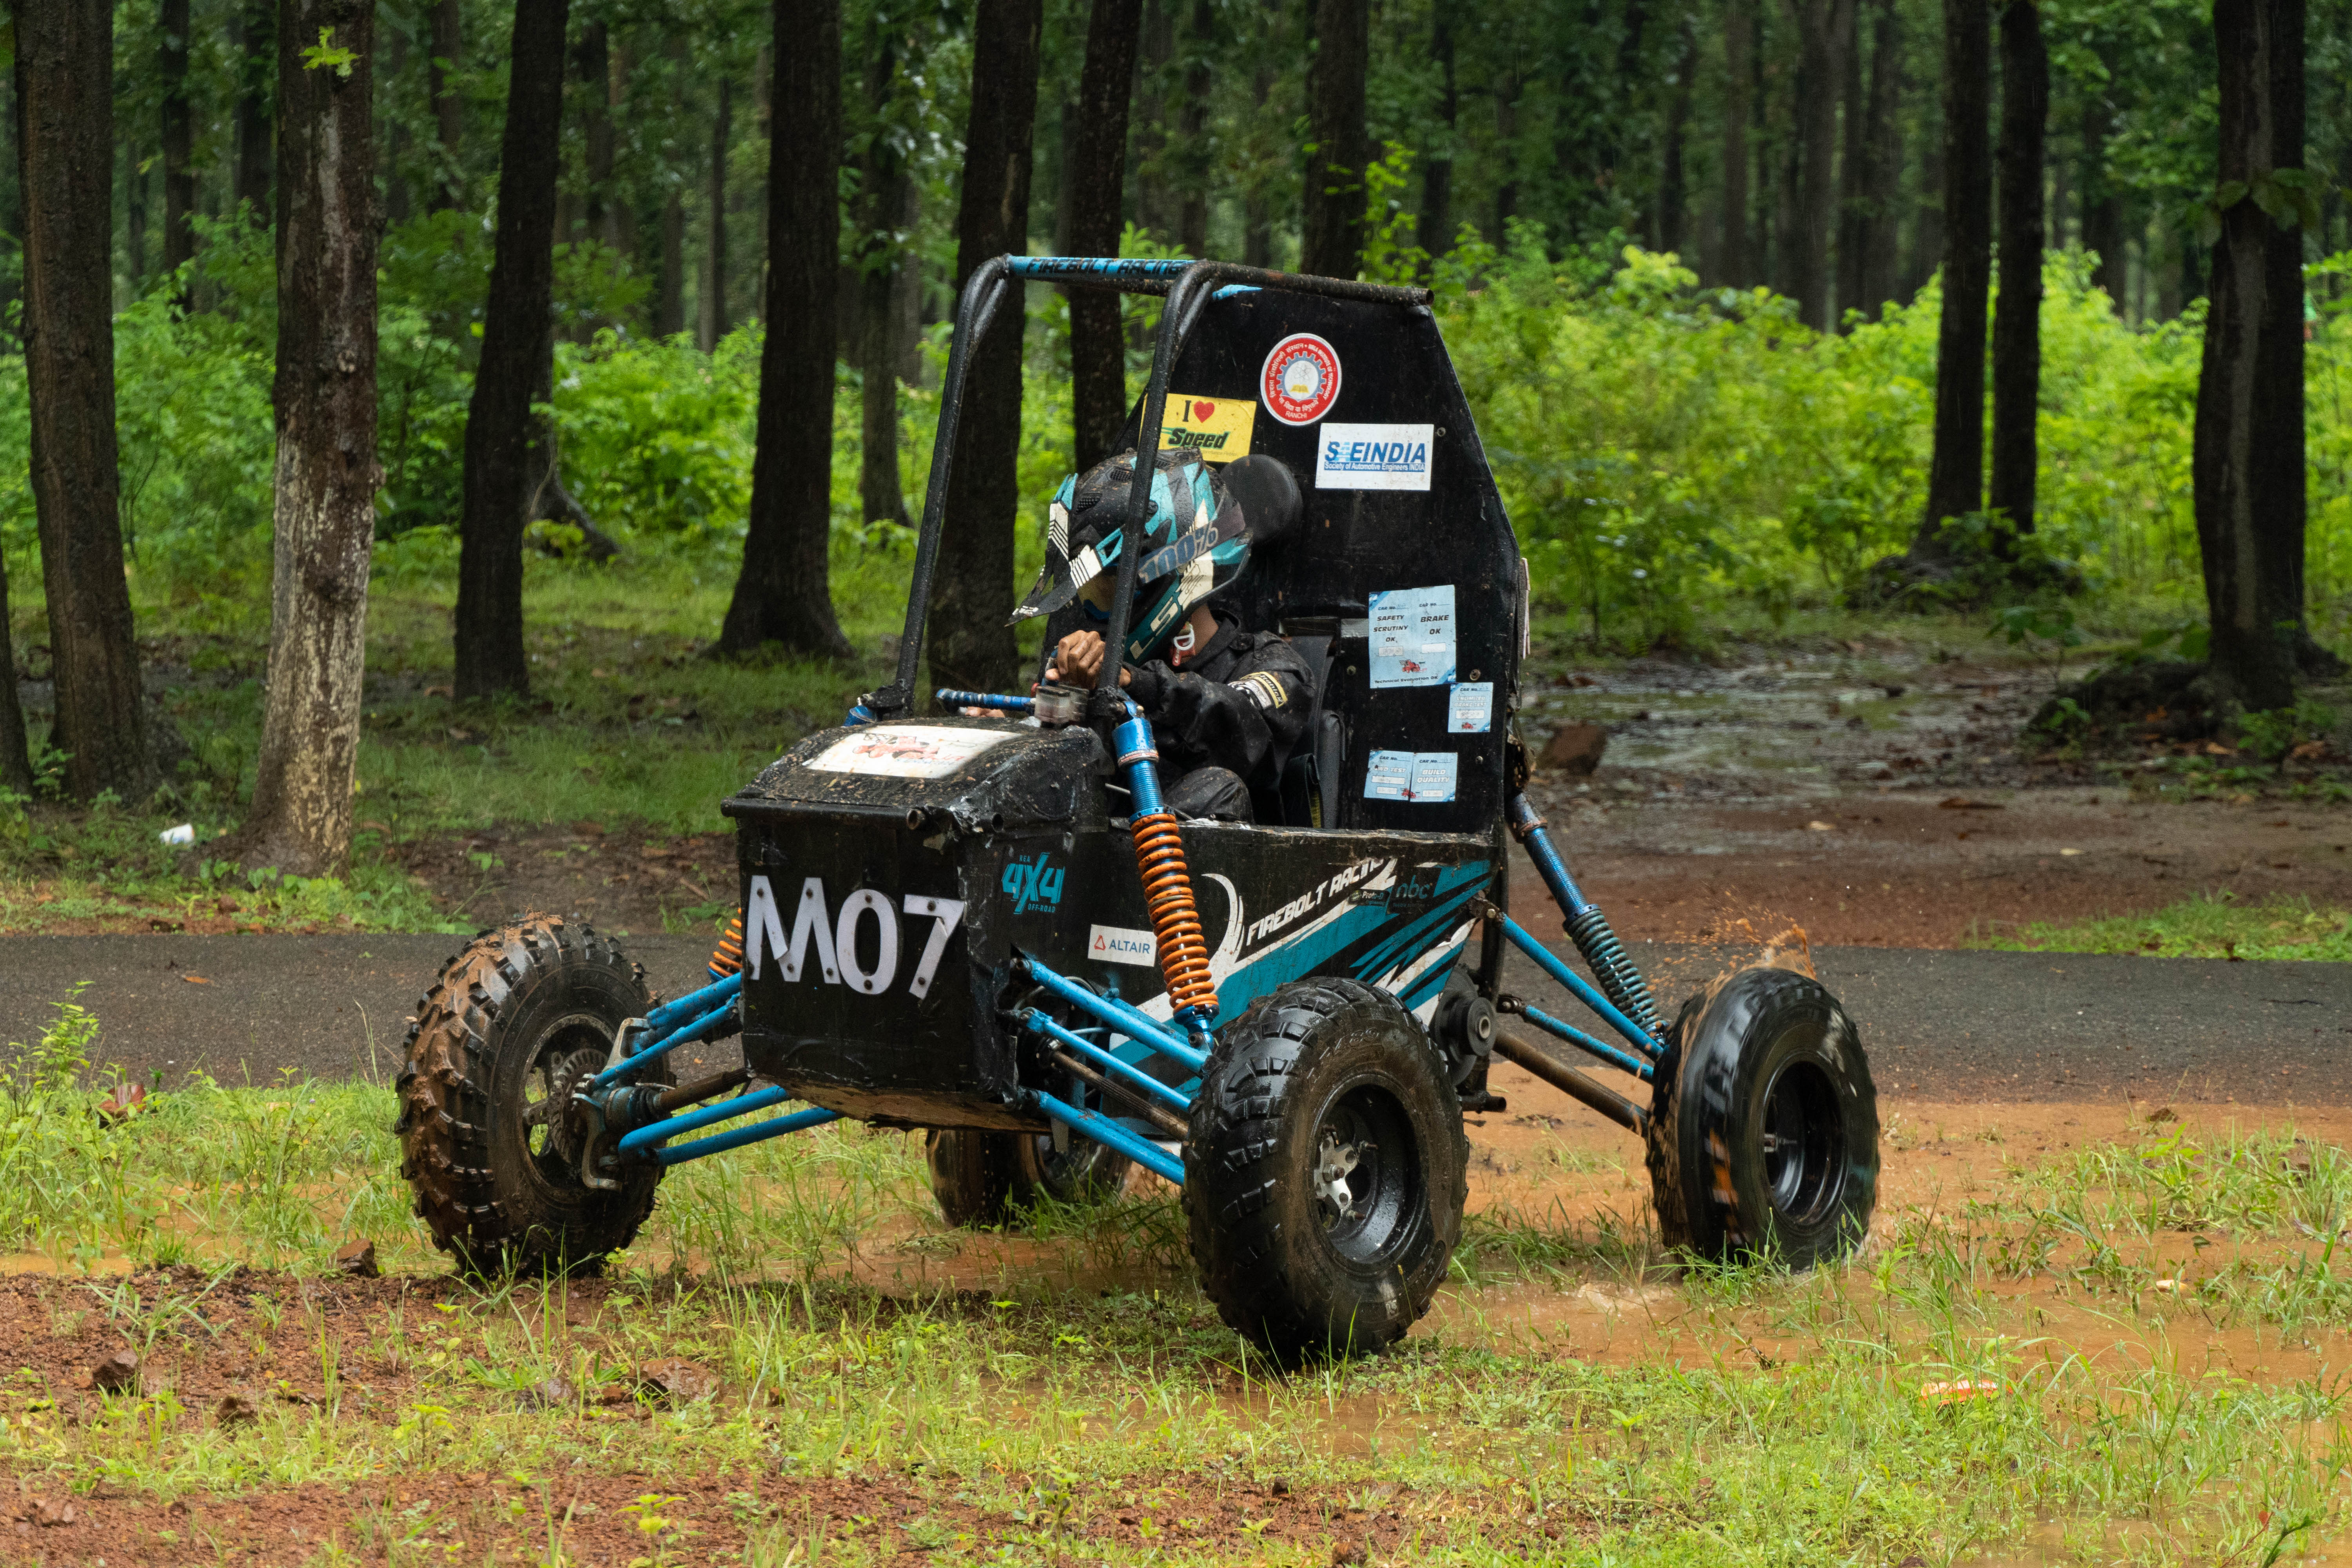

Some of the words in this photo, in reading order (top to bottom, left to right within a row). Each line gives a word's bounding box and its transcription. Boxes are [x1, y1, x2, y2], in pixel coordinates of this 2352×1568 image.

[1182, 400, 1191, 422] I
[1168, 427, 1230, 450] Speed
[1381, 463, 1408, 472] Engineers
[1138, 524, 1218, 584] 100%
[1420, 614, 1449, 622] BRAKE
[1396, 875, 1430, 899] nbc
[1027, 903, 1055, 913] OFF-ROAD
[1246, 880, 1328, 946] FIREBOLT
[746, 875, 964, 1000] M07
[1109, 939, 1150, 954] ALTAIR
